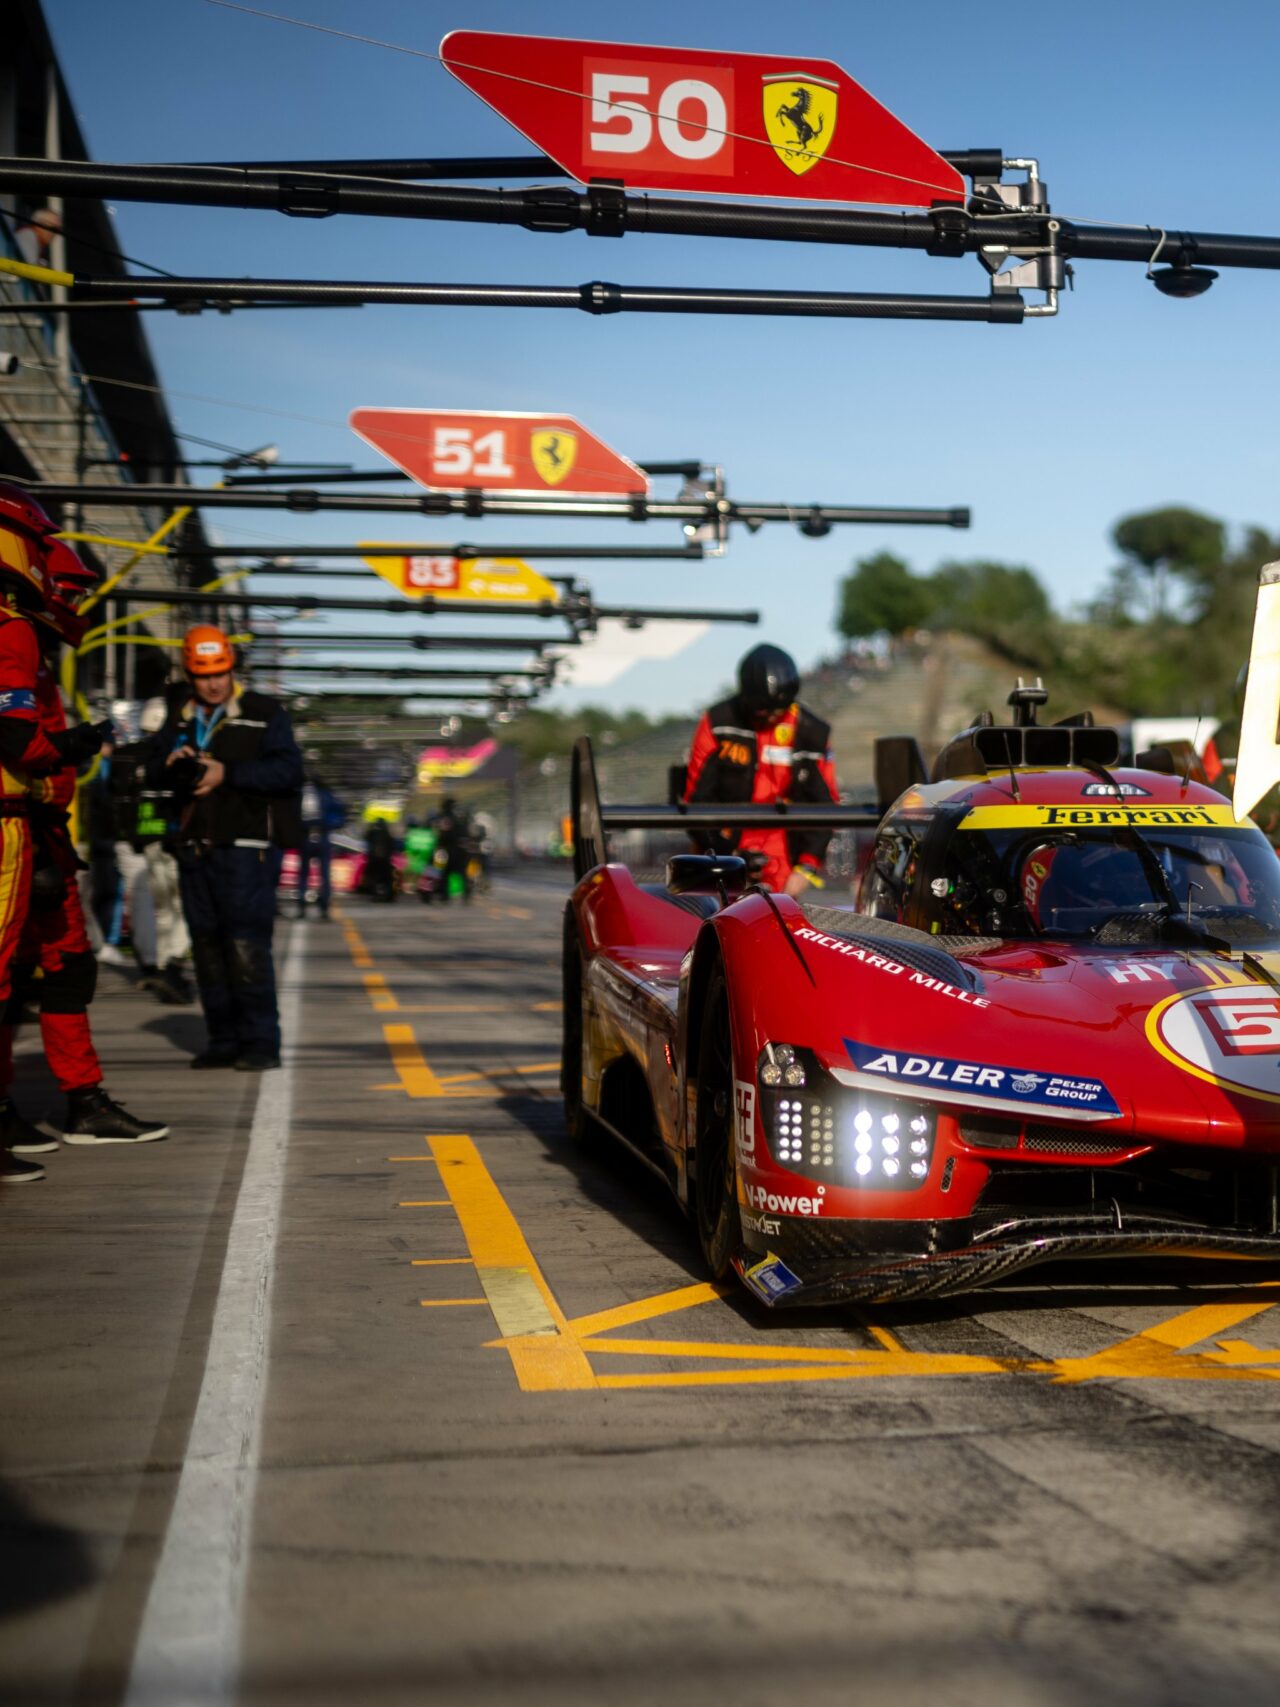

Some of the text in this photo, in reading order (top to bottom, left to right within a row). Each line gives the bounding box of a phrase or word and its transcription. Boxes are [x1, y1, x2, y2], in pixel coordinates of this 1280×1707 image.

[590, 72, 727, 160] 50
[432, 427, 514, 478] 51
[408, 557, 456, 587] 83
[1041, 805, 1218, 825] Ferrari
[794, 927, 992, 1008] RICHARD MILLE
[1104, 963, 1177, 983] HY
[862, 1054, 1005, 1088] ADLER
[1049, 1077, 1102, 1093] PELZER
[1045, 1087, 1098, 1101] GROUP
[745, 1183, 824, 1215] V-Power
